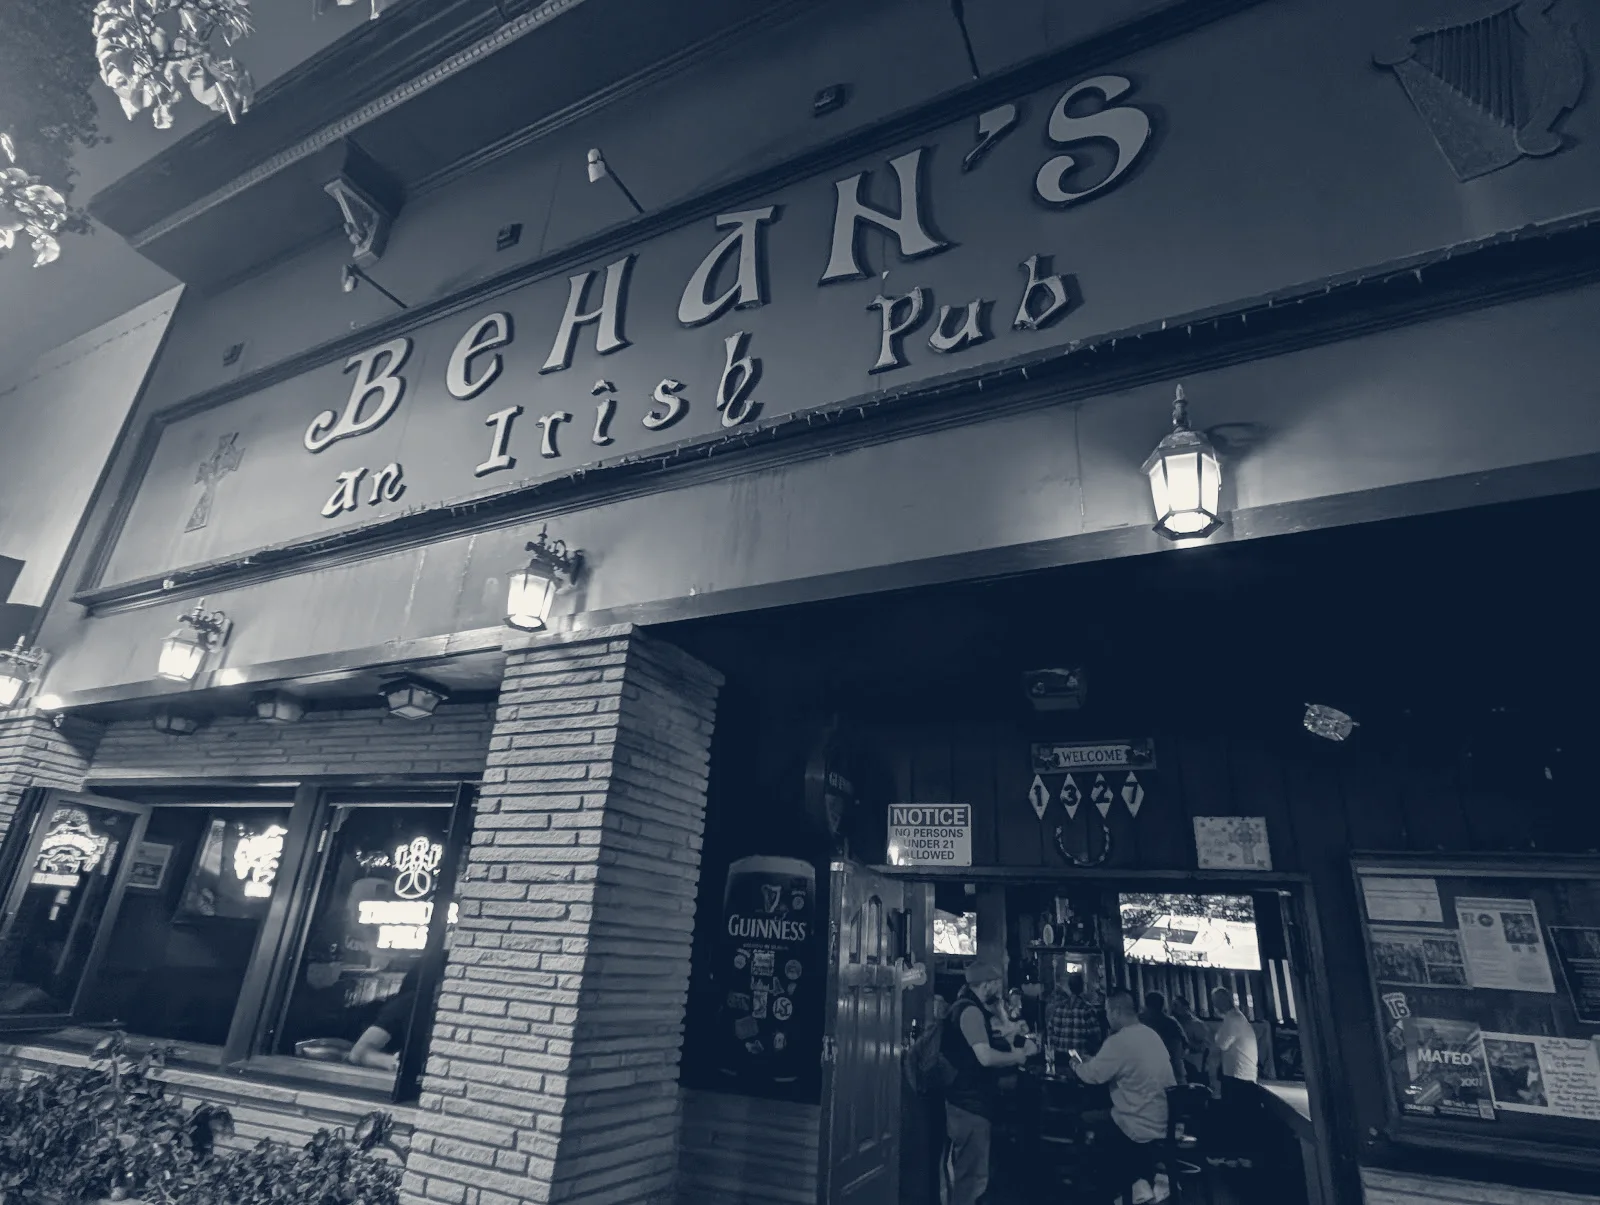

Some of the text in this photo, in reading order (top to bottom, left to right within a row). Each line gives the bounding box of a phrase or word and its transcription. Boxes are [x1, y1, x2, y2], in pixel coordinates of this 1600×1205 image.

[320, 254, 1073, 518] an Irish Pub
[1061, 748, 1124, 764] WELCOME
[893, 808, 966, 825] NOTICE
[895, 828, 964, 838] NO PERSONS
[904, 839, 954, 849] UNDER 21
[728, 913, 808, 941] GUINNESS
[1417, 1046, 1473, 1066] MATEO
